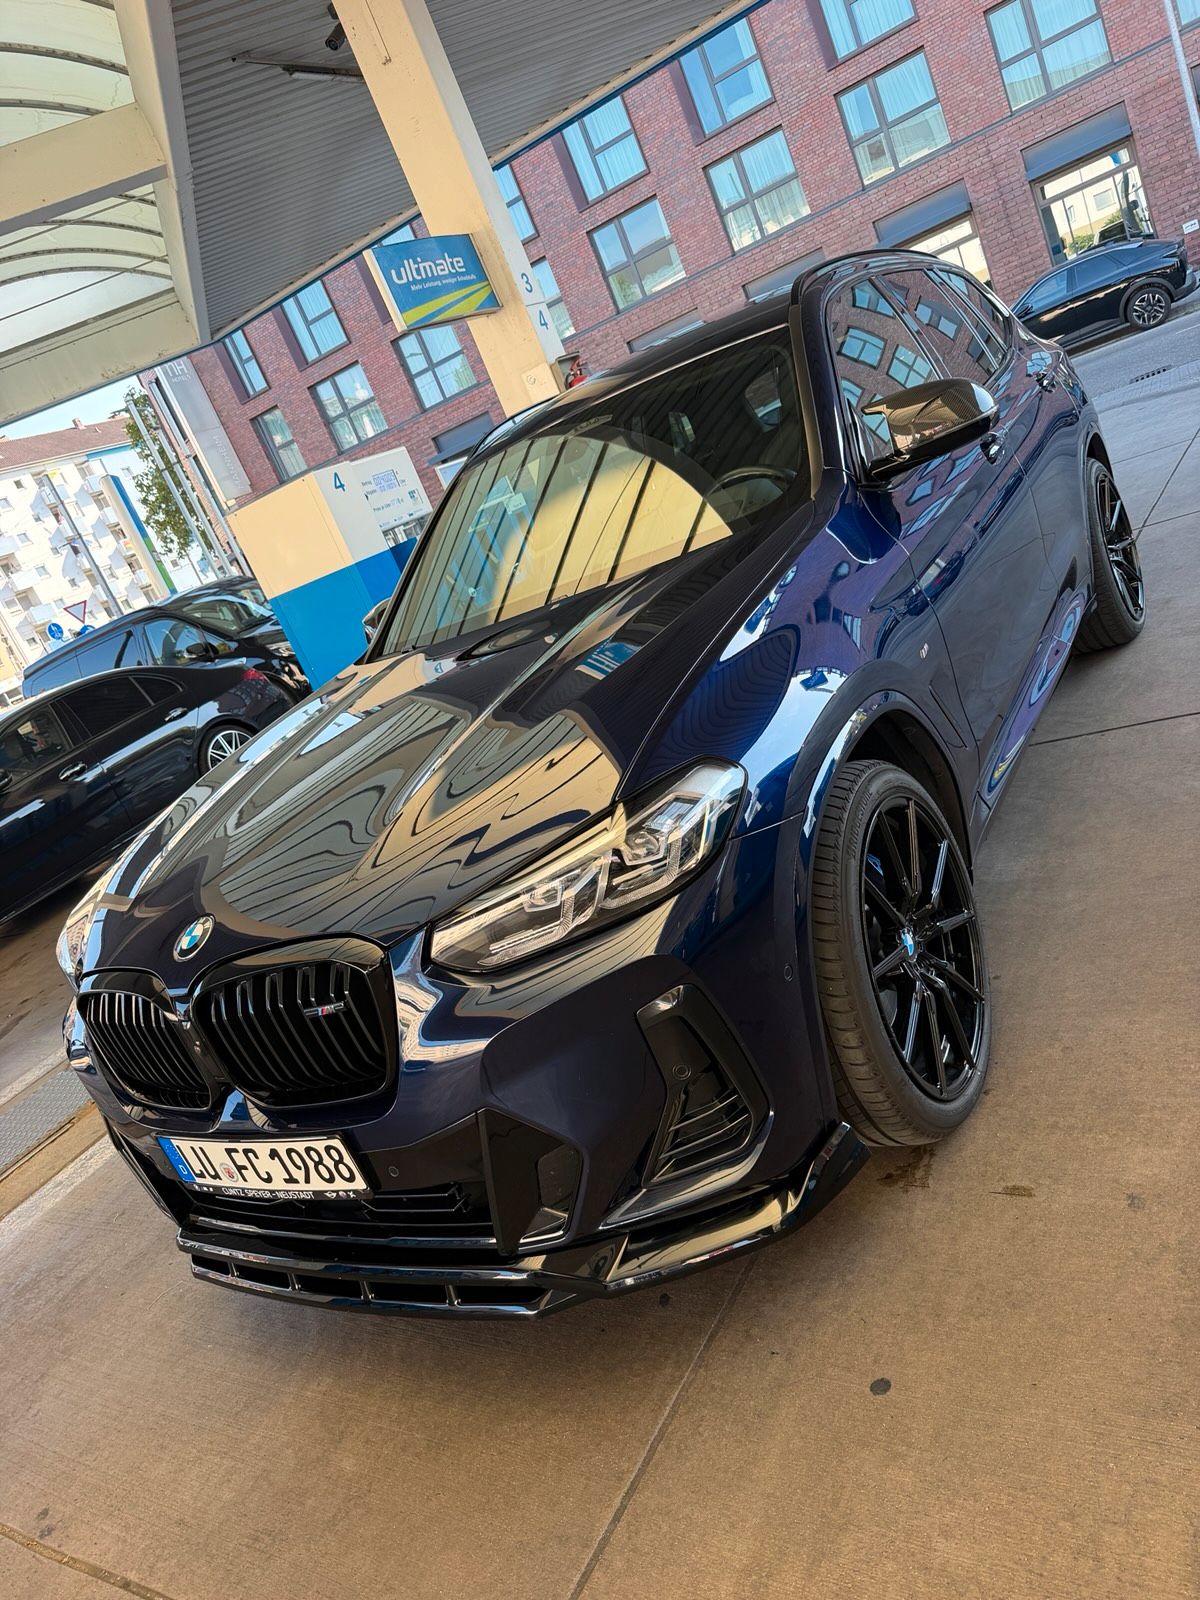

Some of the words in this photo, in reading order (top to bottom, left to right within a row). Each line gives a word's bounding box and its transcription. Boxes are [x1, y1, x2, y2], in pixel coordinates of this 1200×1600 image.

[390, 252, 466, 285] ultimate
[520, 272, 533, 293] 3
[538, 309, 549, 331] 4
[333, 471, 346, 492] 4
[176, 1144, 222, 1181] LU
[224, 1147, 273, 1184] FC
[268, 1144, 356, 1184] 1988
[178, 1164, 188, 1176] D
